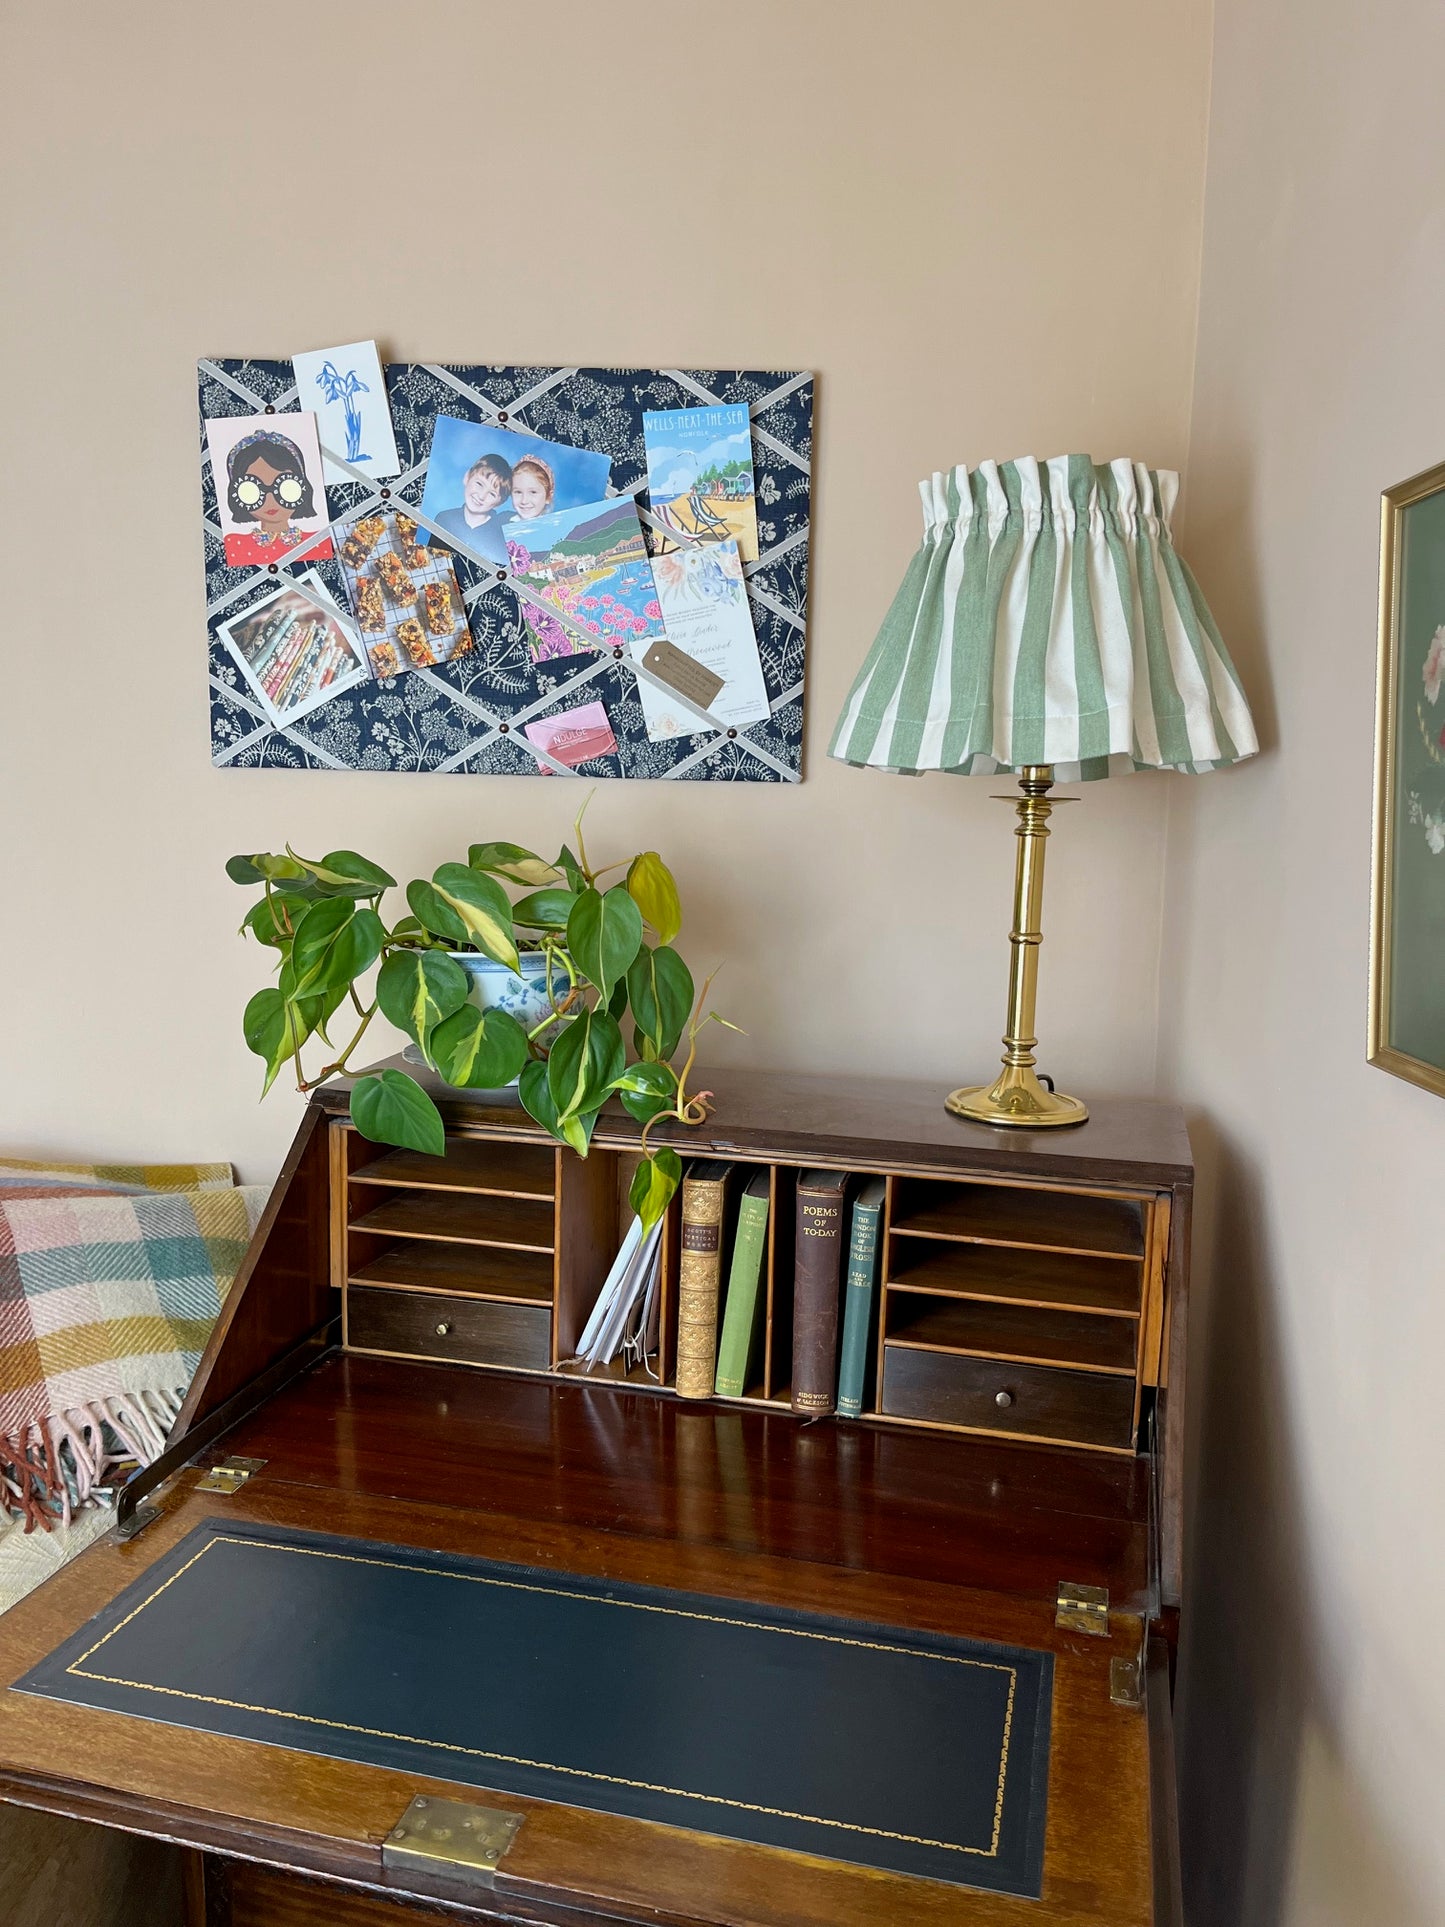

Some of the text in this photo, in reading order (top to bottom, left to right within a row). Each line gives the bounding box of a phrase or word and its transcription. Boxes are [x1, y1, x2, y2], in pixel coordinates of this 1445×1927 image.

[645, 411, 743, 431] WELLS-NEXT-THE-SEA
[234, 475, 261, 488] HAPPY
[274, 475, 306, 494] BIRTHDAY
[232, 491, 265, 510] BIRTHDAY
[279, 498, 305, 508] GIRL!
[803, 1205, 838, 1217] POEMS
[814, 1219, 827, 1227] OF
[803, 1227, 838, 1237] TO-DAY
